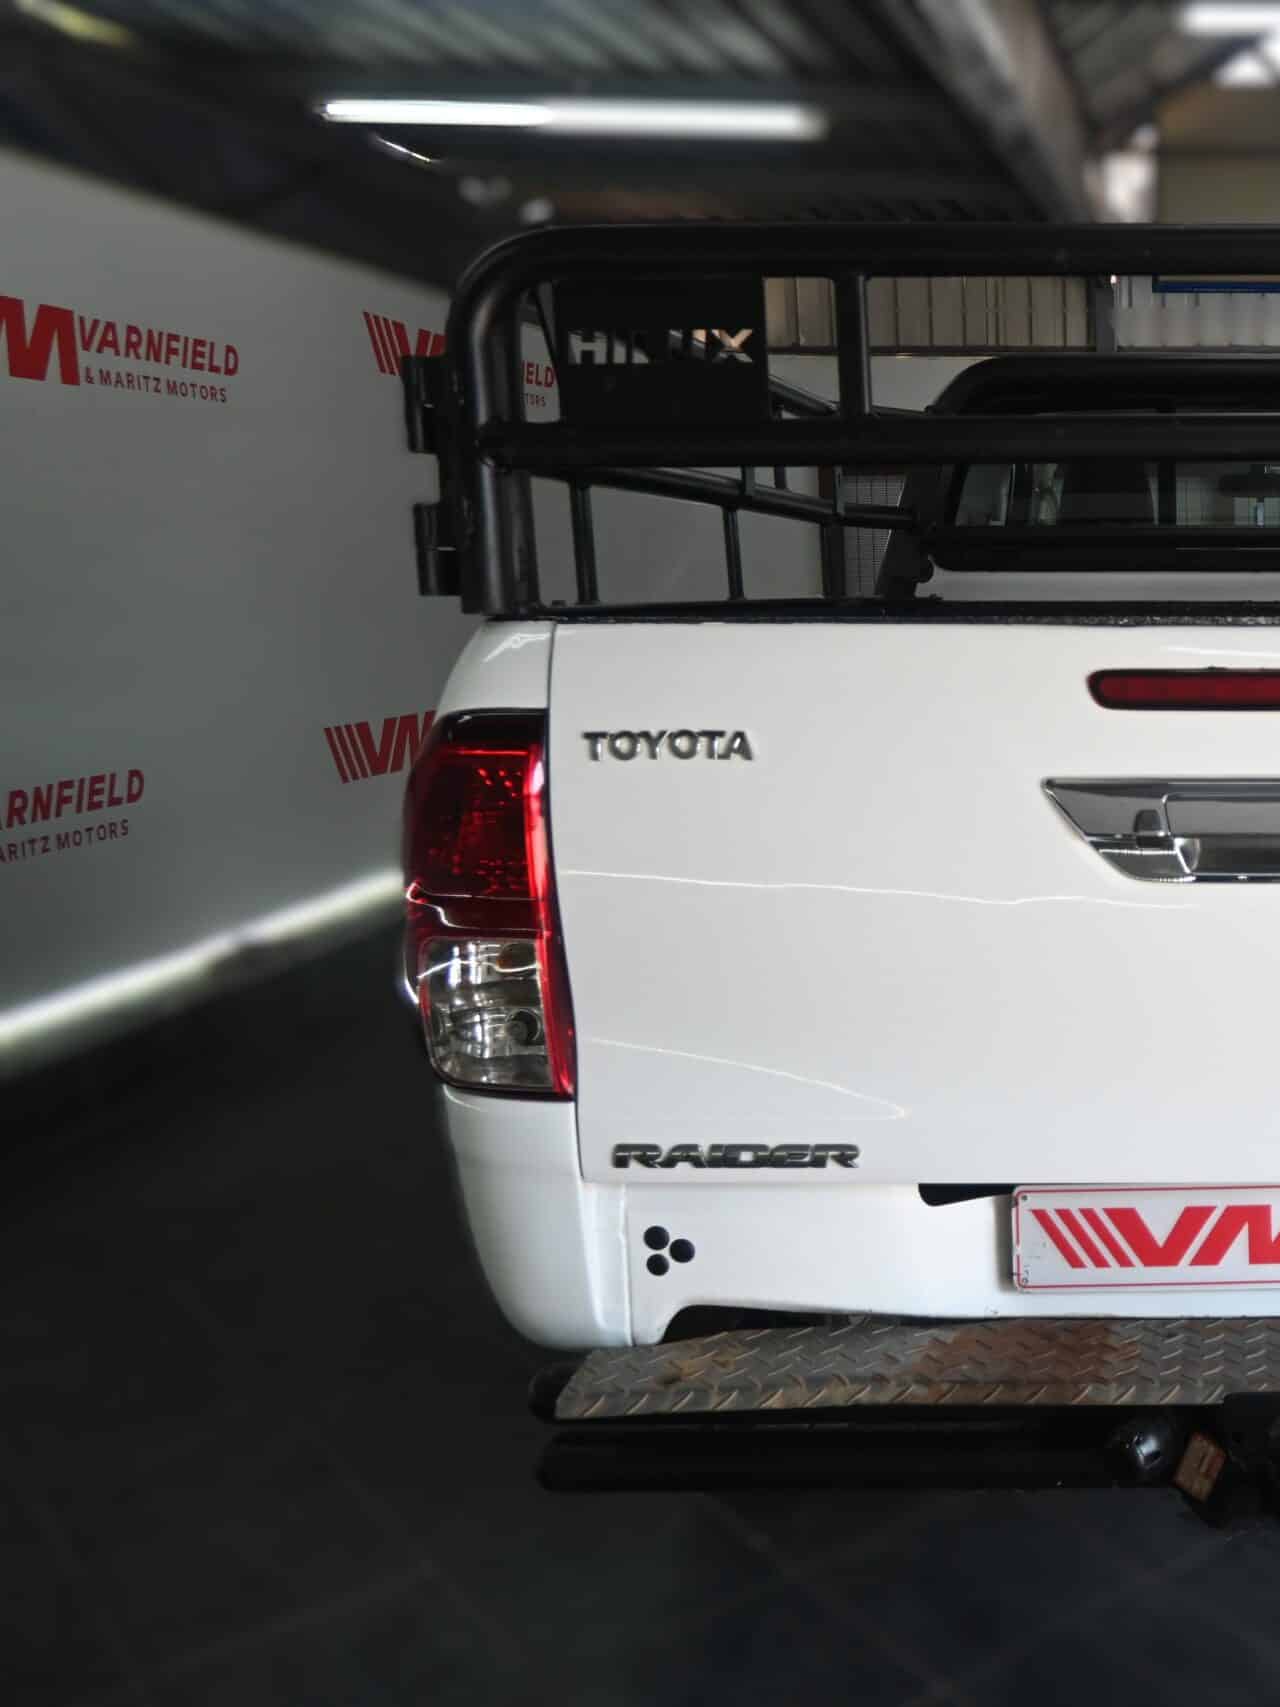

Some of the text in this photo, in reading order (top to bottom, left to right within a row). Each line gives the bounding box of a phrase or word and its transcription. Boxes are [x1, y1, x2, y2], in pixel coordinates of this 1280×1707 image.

[78, 315, 240, 377] VARNFIELD
[85, 367, 228, 404] & MARITZ MOTORS
[582, 730, 754, 761] TOYOTA
[0, 769, 145, 831] RNFIELD
[56, 818, 129, 851] MOTORS
[612, 1143, 860, 1169] RAIDER
